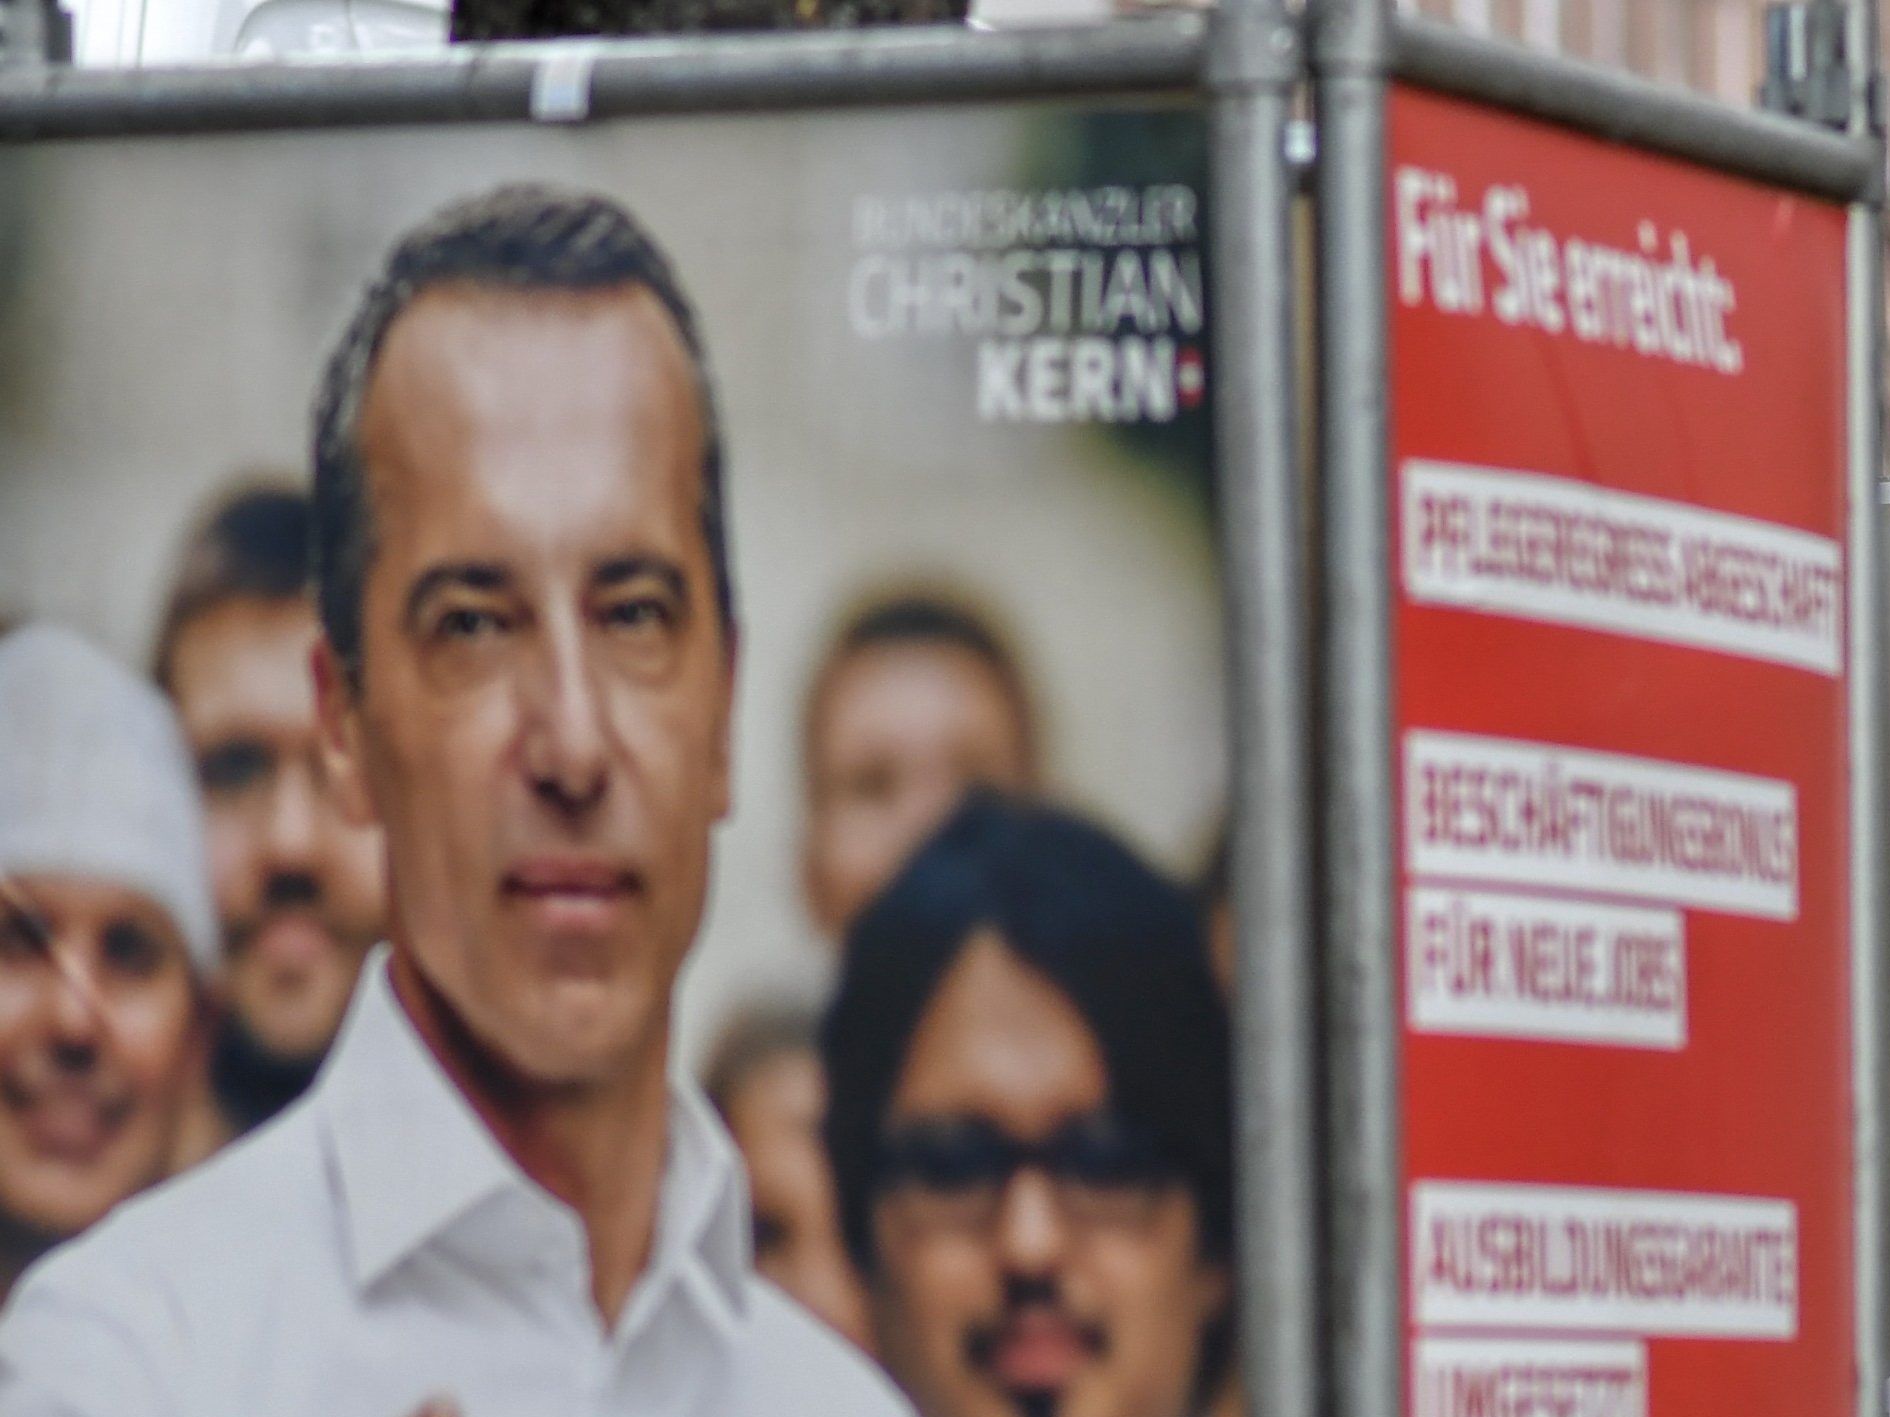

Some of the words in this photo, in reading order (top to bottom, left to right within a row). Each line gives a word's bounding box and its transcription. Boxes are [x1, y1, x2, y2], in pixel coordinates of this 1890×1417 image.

[848, 246, 1202, 338] CHRISTIAN
[1484, 185, 1564, 335] Sie
[977, 335, 1178, 422] KERN
